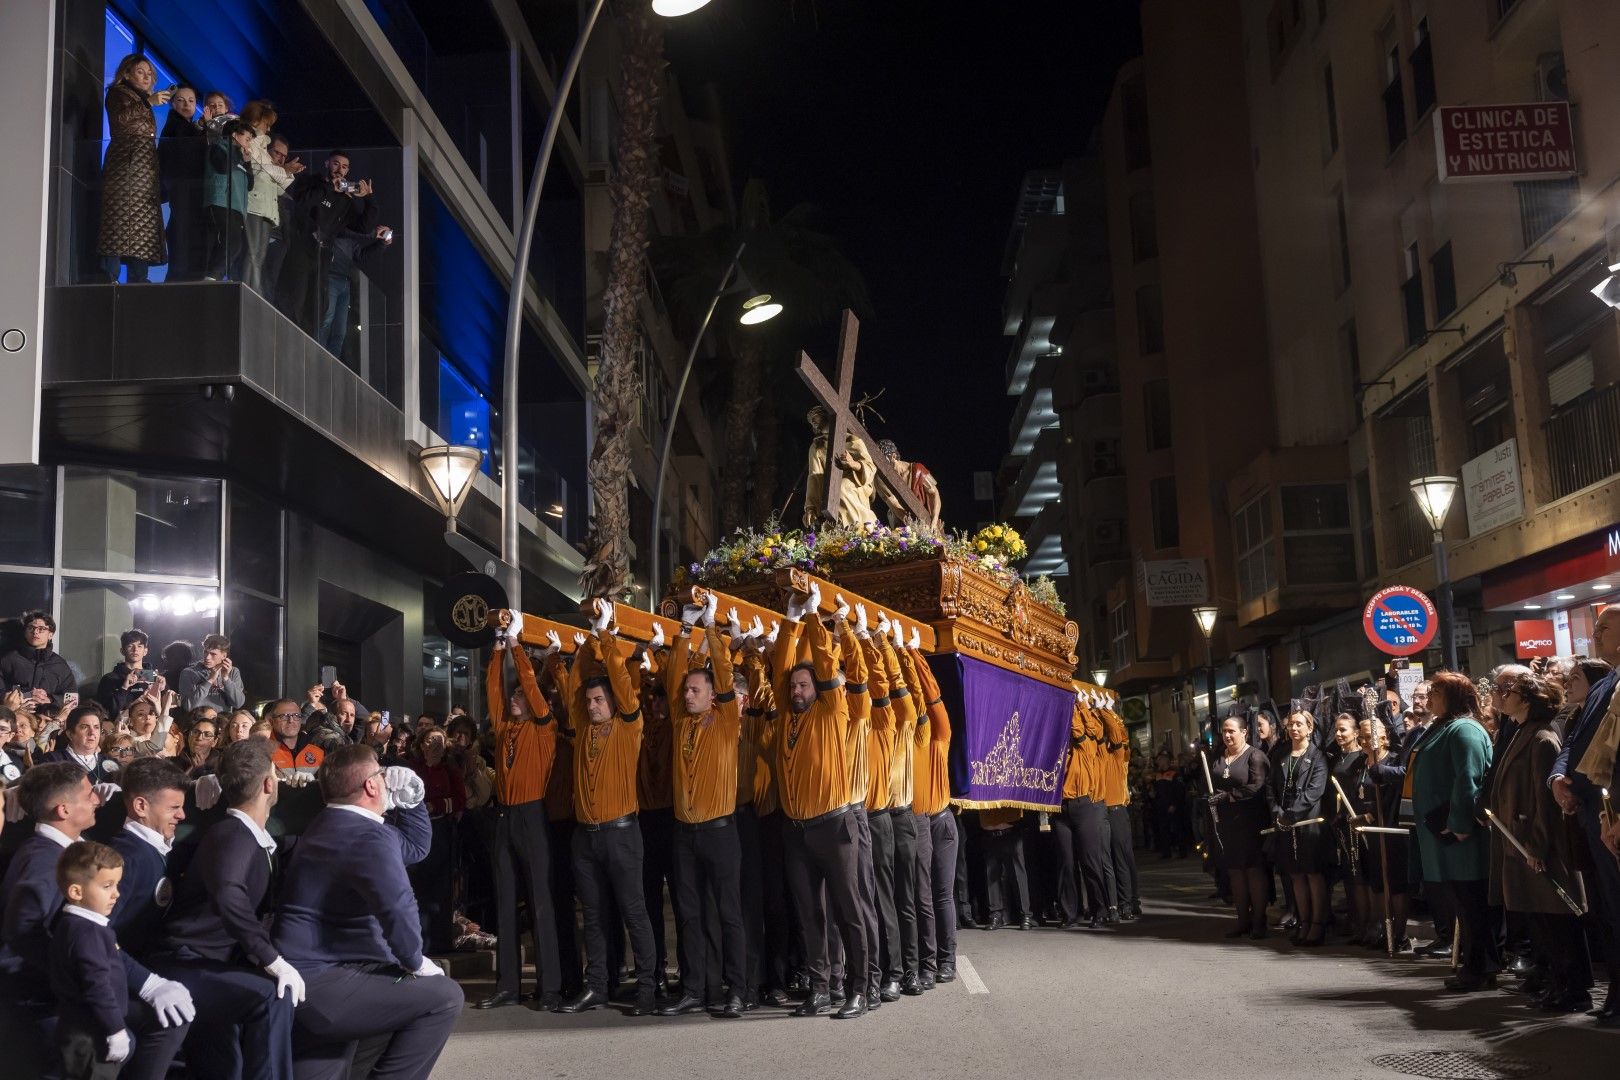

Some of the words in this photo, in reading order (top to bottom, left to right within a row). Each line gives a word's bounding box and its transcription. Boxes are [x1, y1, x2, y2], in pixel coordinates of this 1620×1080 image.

[1451, 109, 1528, 130] CLINICA
[1534, 108, 1559, 126] DE
[1459, 129, 1556, 151] ESTETICA
[1449, 154, 1461, 172] Y
[1468, 149, 1571, 172] NUTRICION
[1148, 572, 1203, 586] CAGIDA
[1366, 593, 1382, 618] EXCEPTO
[1382, 586, 1404, 594] CARGA
[1411, 589, 1434, 616] DESCARGA
